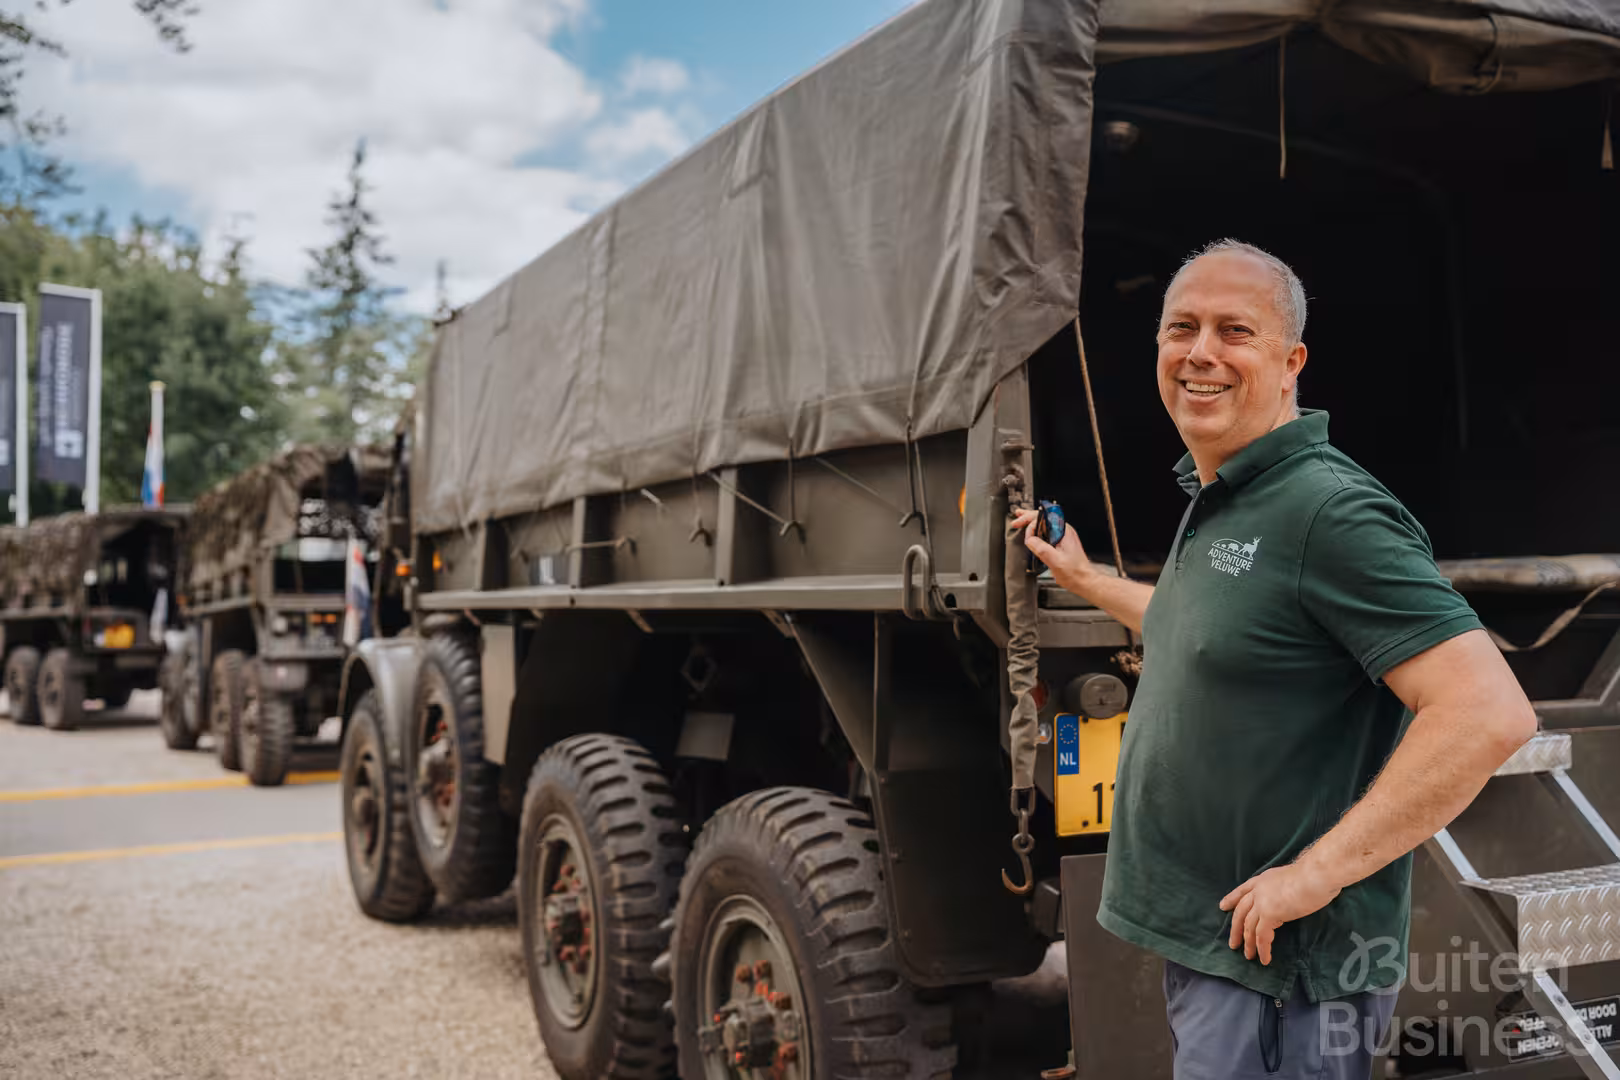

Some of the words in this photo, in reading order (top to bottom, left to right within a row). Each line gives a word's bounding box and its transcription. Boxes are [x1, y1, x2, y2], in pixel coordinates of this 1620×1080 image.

[1208, 547, 1253, 571] ADVENTURE
[1211, 558, 1241, 577] VELUWE
[1060, 752, 1077, 766] NL
[1588, 1003, 1617, 1020] DOOR
